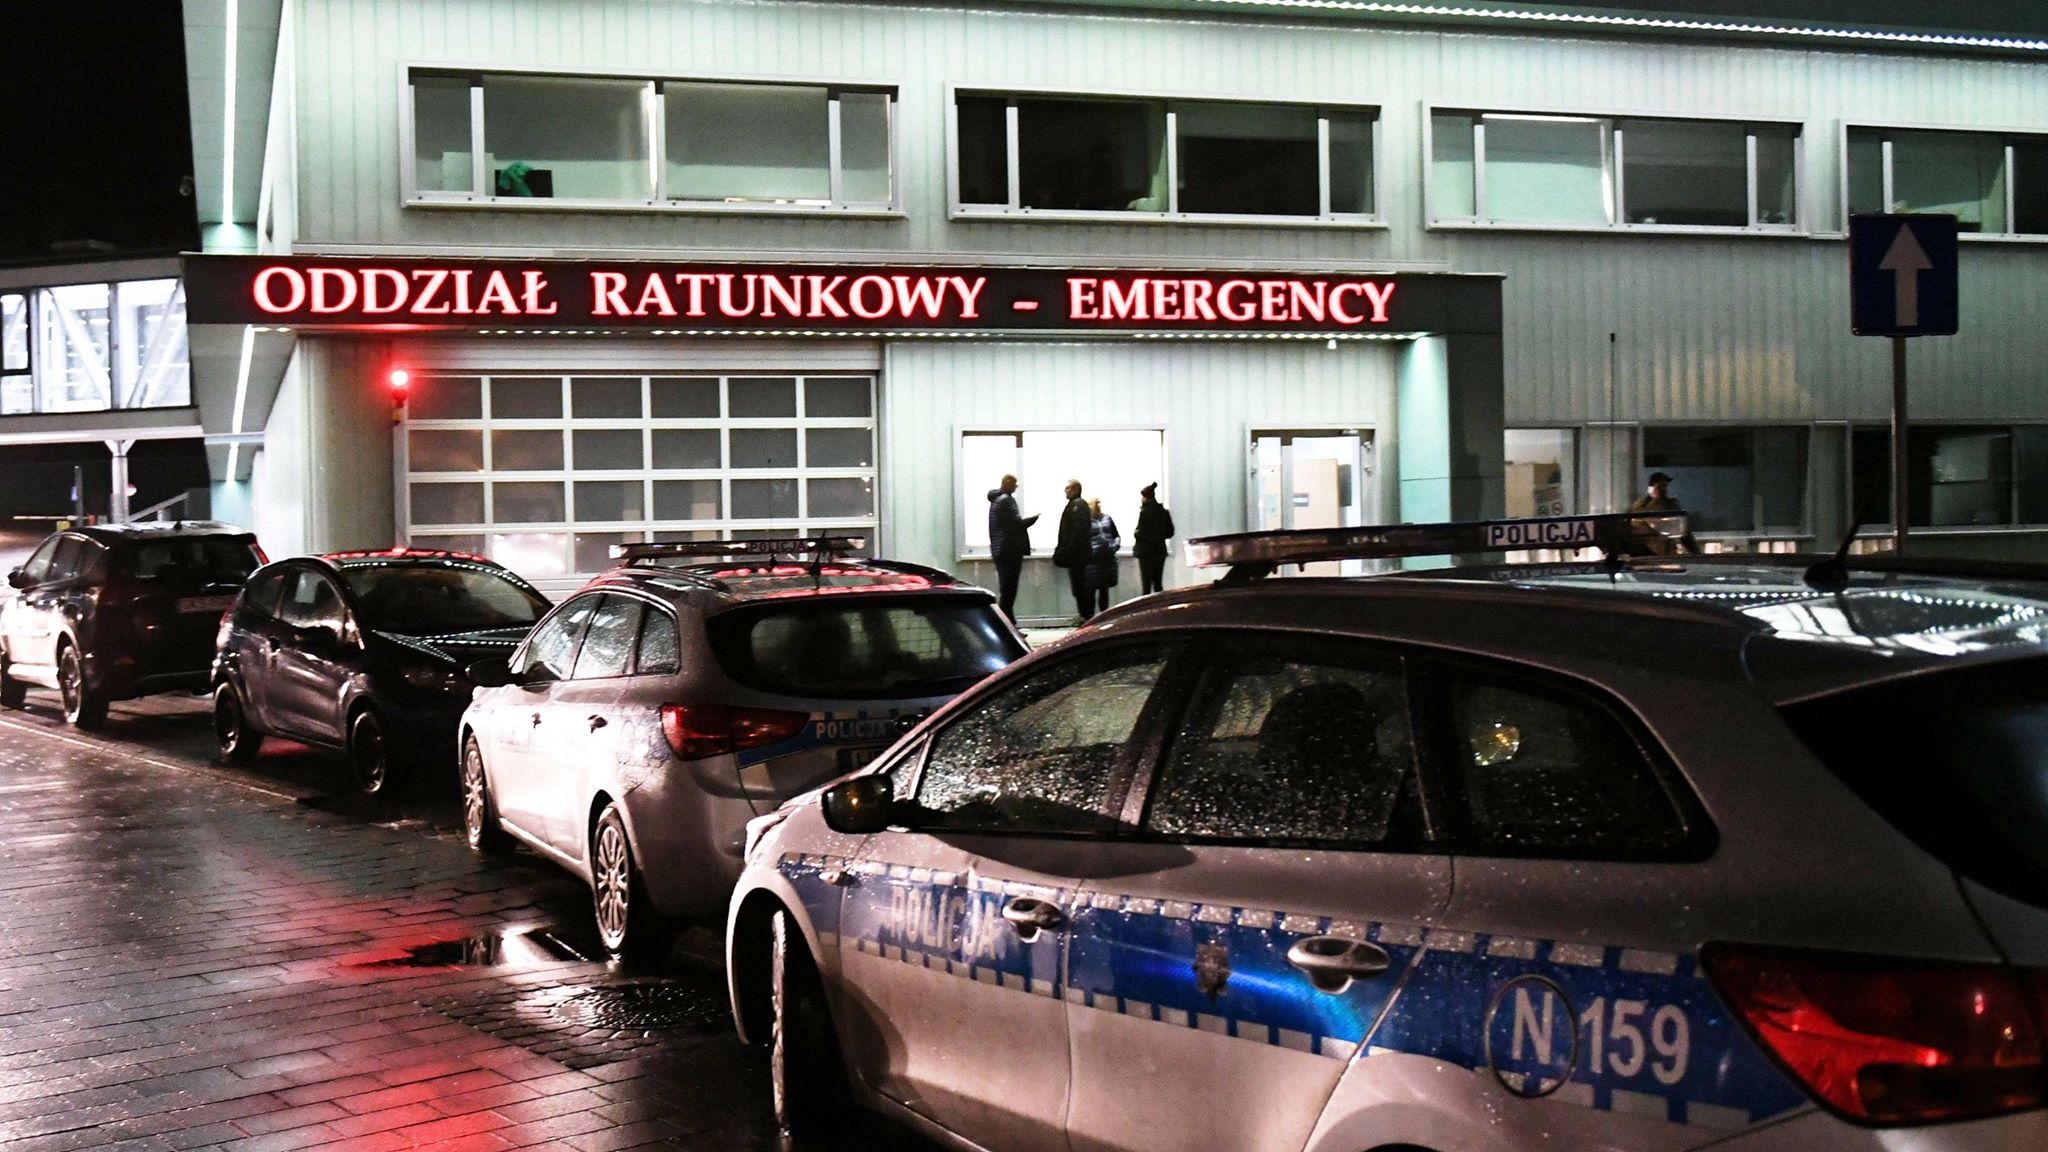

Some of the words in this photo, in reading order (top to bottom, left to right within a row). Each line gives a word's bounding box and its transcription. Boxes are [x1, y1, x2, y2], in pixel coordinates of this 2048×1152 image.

[253, 266, 557, 314] ODDZIAŁ
[590, 271, 986, 319] RATUNKOWY
[1067, 278, 1397, 323] EMERGENCY
[752, 541, 806, 552] POLICJA
[1491, 522, 1588, 544] POLICJA
[814, 721, 887, 739] POLICJA
[889, 886, 1006, 960] POLICJA
[1511, 987, 1552, 1064] N
[1580, 997, 1690, 1084] 159
